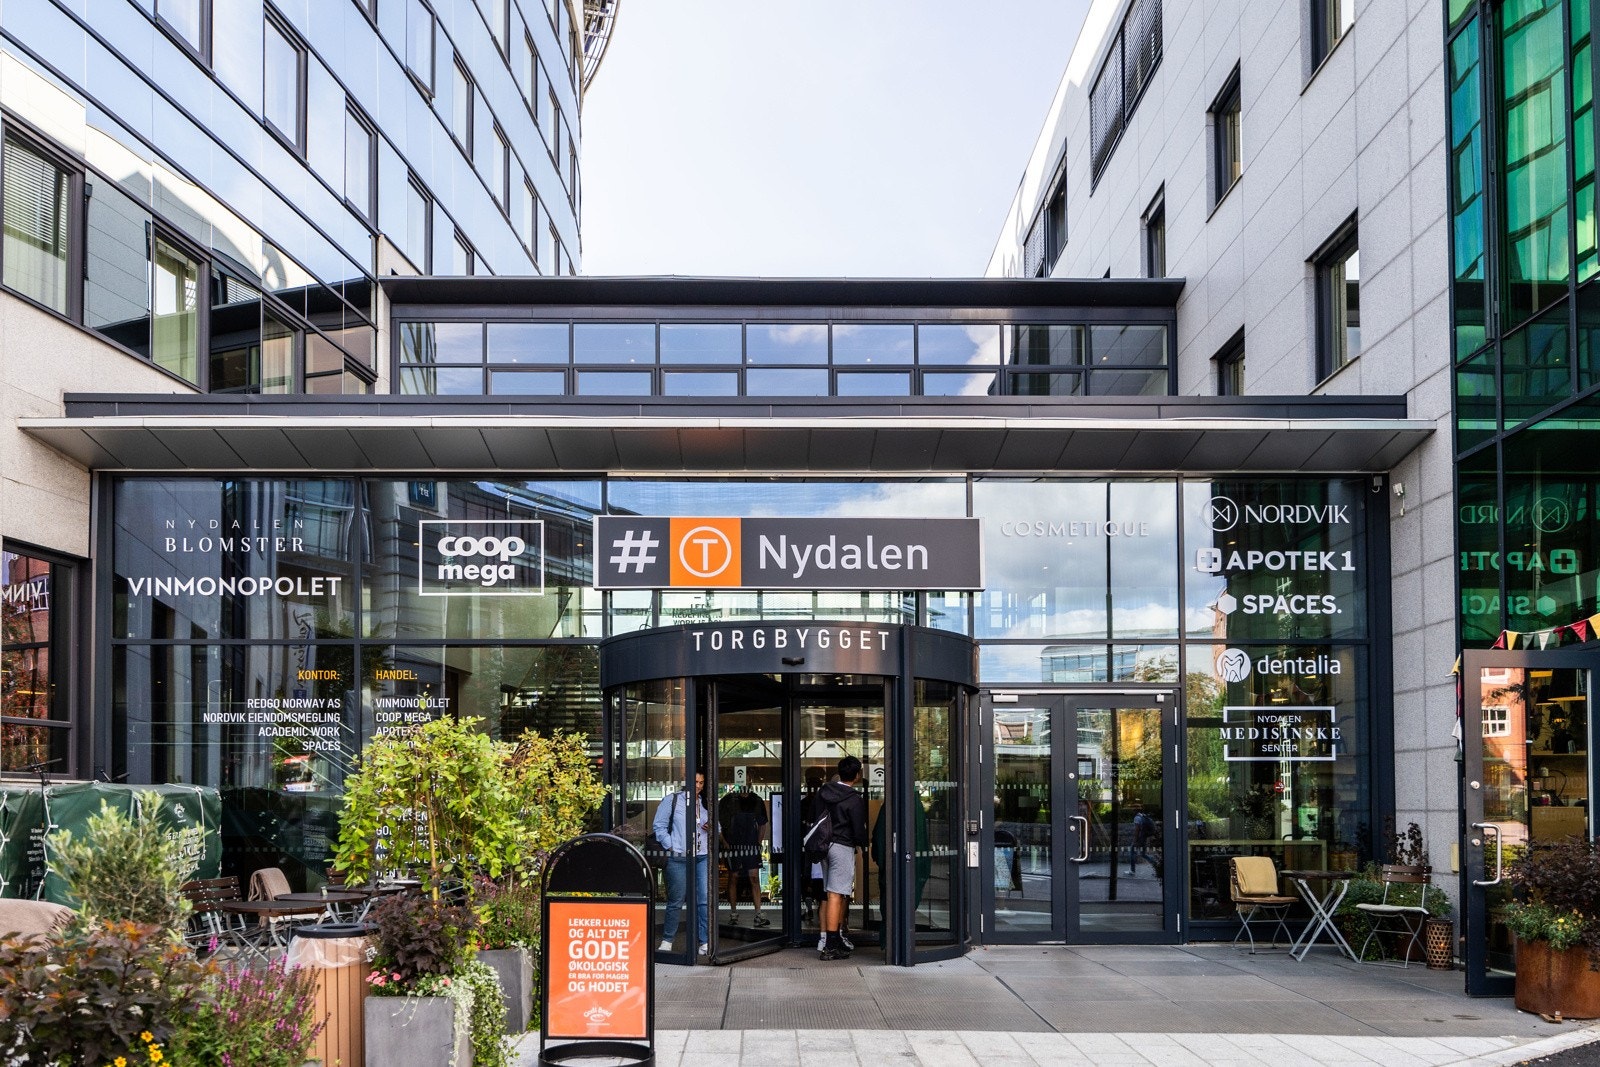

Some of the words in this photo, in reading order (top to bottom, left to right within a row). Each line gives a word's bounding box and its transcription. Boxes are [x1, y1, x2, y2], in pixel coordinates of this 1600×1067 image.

[1244, 504, 1350, 525] NORDVIK
[166, 519, 304, 529] NYDALEN
[1000, 520, 1150, 538] COSMETIQUE
[165, 537, 304, 552] BLOMSTER
[437, 536, 526, 562] coop
[759, 534, 929, 579] Nydalen
[1226, 551, 1337, 571] APOTEK
[1341, 551, 1356, 571] 1
[437, 564, 516, 587] mega
[127, 576, 342, 597] VINMONOPOLET
[1242, 594, 1343, 615] SPACES.
[692, 628, 890, 652] TORGBYGGET
[1256, 654, 1342, 675] dentalia
[298, 670, 341, 680] KONTOR:
[375, 669, 418, 680] HANDEL:
[247, 698, 280, 709] REDGO
[282, 698, 325, 709] NORWAY
[327, 698, 341, 709] AS
[375, 697, 451, 708] VINMONOOLET
[203, 712, 246, 723] NORDVIK
[248, 712, 341, 723] EIENDOMSMEGLING
[375, 712, 402, 722] COOP
[404, 712, 432, 722] MEGA
[1257, 715, 1302, 723] NYDALEN
[258, 726, 309, 737] ACADEMIC
[311, 726, 341, 737] WORK
[1218, 727, 1341, 740] MEDISINSKE
[302, 740, 341, 751] SPACES
[1261, 744, 1299, 752] SENTER
[568, 918, 602, 927] LEKKER
[603, 918, 630, 928] LUNSJ
[568, 928, 585, 939] OG
[587, 929, 607, 939] ALT
[608, 929, 630, 939] DET
[568, 940, 630, 960] GODE
[568, 960, 629, 972] ØKOLOGISK
[577, 972, 591, 980] BRA
[568, 981, 586, 992] OG
[588, 981, 629, 993] HODET
